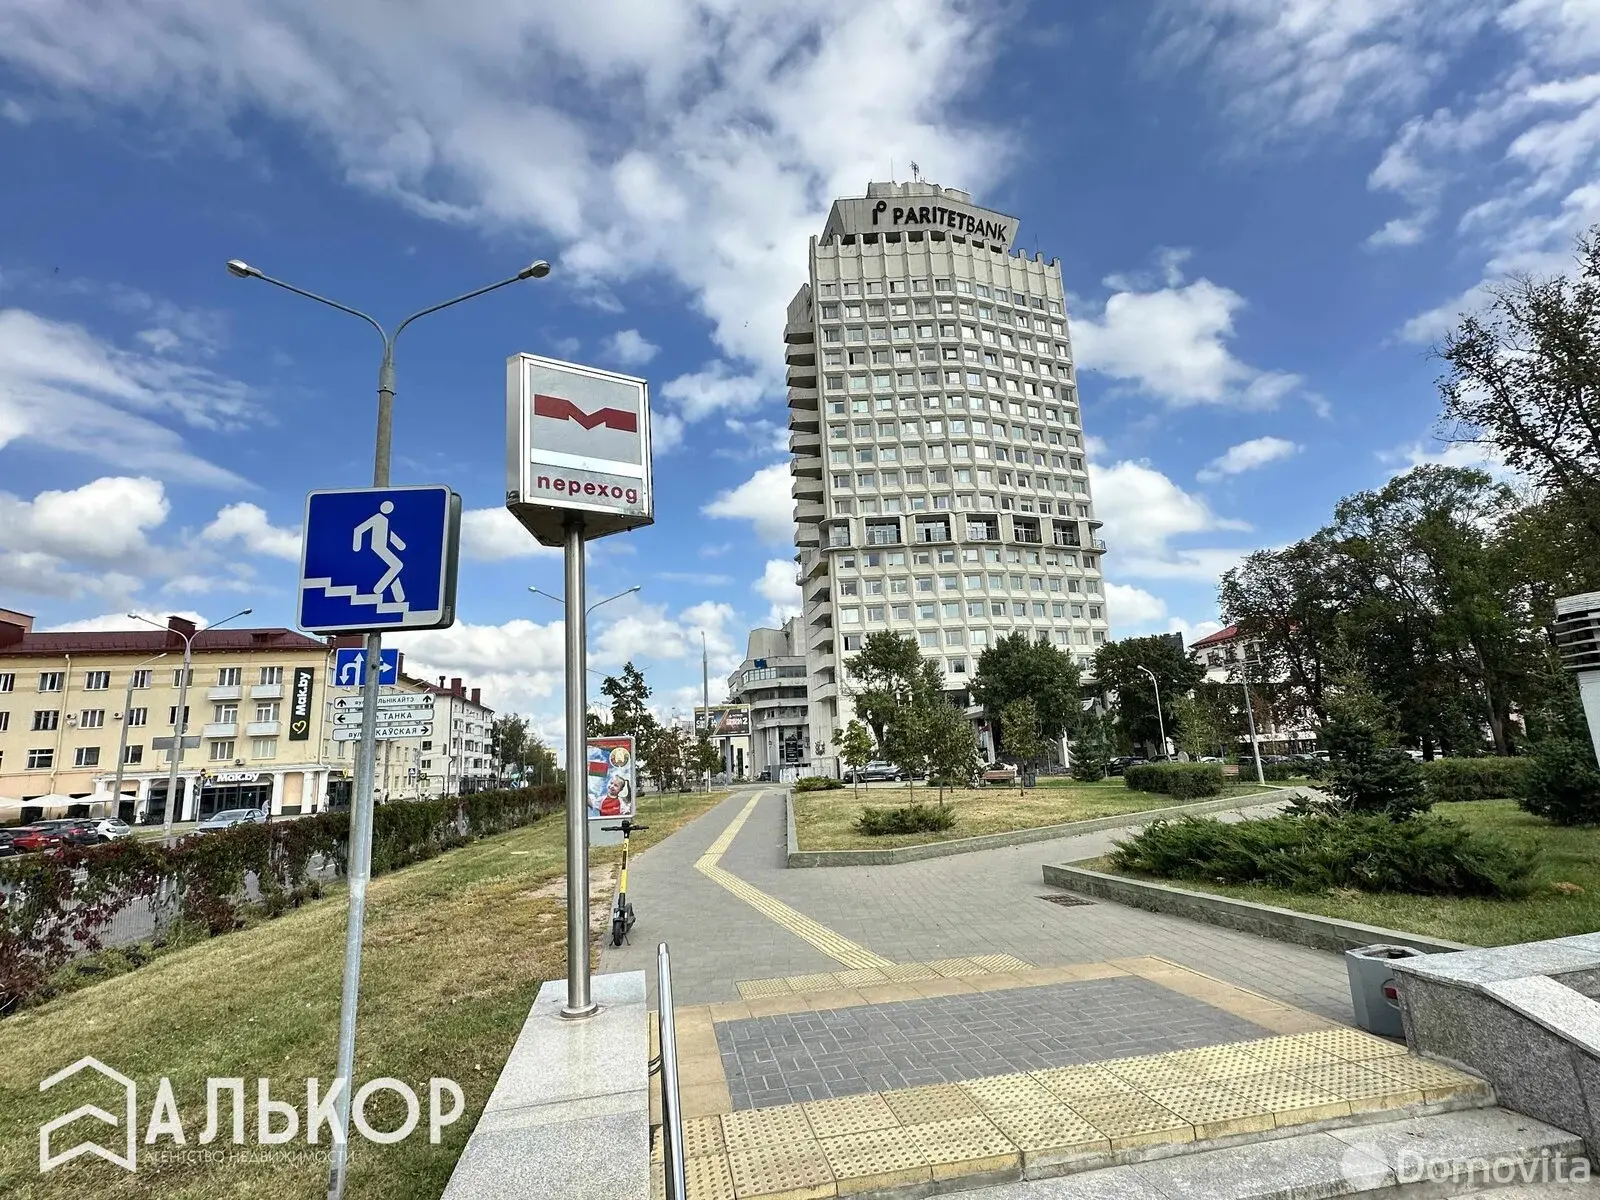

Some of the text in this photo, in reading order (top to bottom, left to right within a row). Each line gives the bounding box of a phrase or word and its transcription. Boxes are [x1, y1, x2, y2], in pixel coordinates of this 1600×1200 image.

[893, 205, 1008, 243] PARITETBANK
[537, 475, 637, 505] переход
[383, 712, 412, 720] ТАНКА
[375, 727, 417, 736] КАЎСКАЯ
